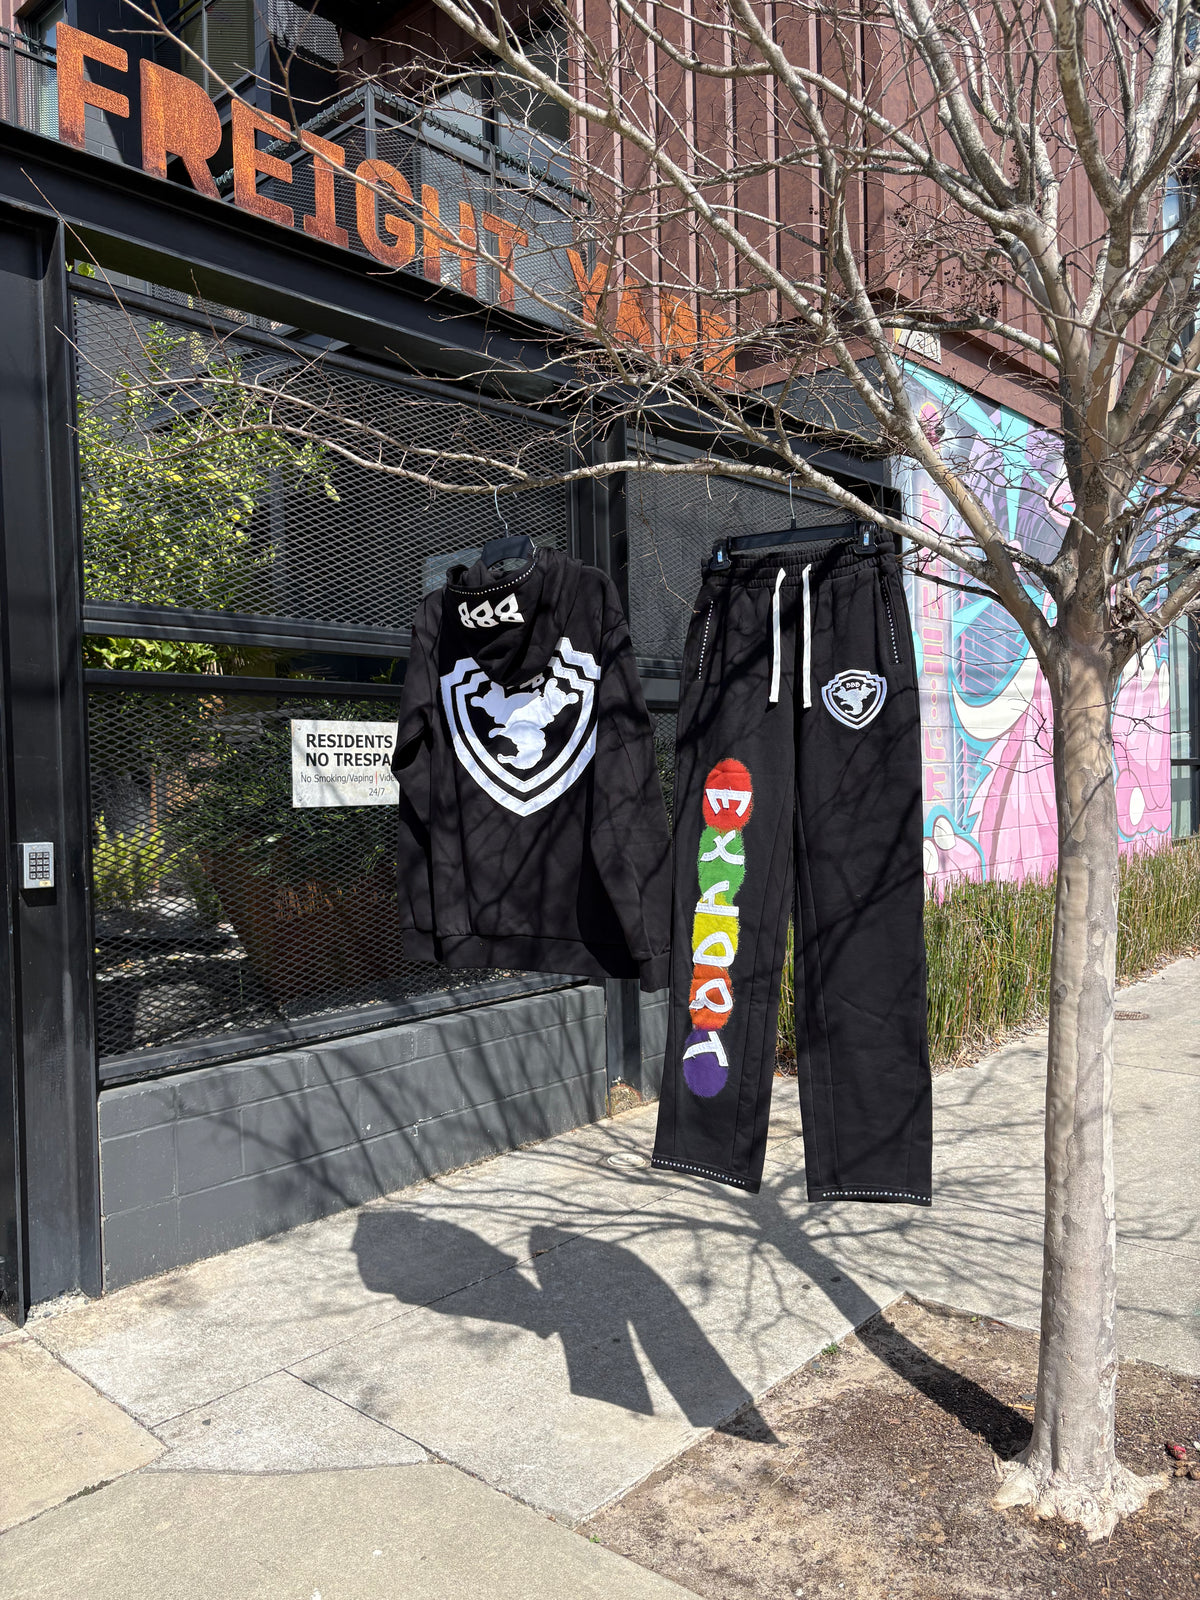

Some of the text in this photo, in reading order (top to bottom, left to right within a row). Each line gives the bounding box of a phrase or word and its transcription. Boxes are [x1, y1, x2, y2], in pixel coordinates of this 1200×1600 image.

[56, 22, 529, 312] FREIGHT
[306, 734, 393, 748] RESIDENTS
[305, 753, 329, 766] NO
[301, 773, 312, 783] No
[314, 773, 374, 785] Smoking/Vaping
[368, 787, 385, 797] 24/7
[683, 788, 752, 1067] EXHORT
